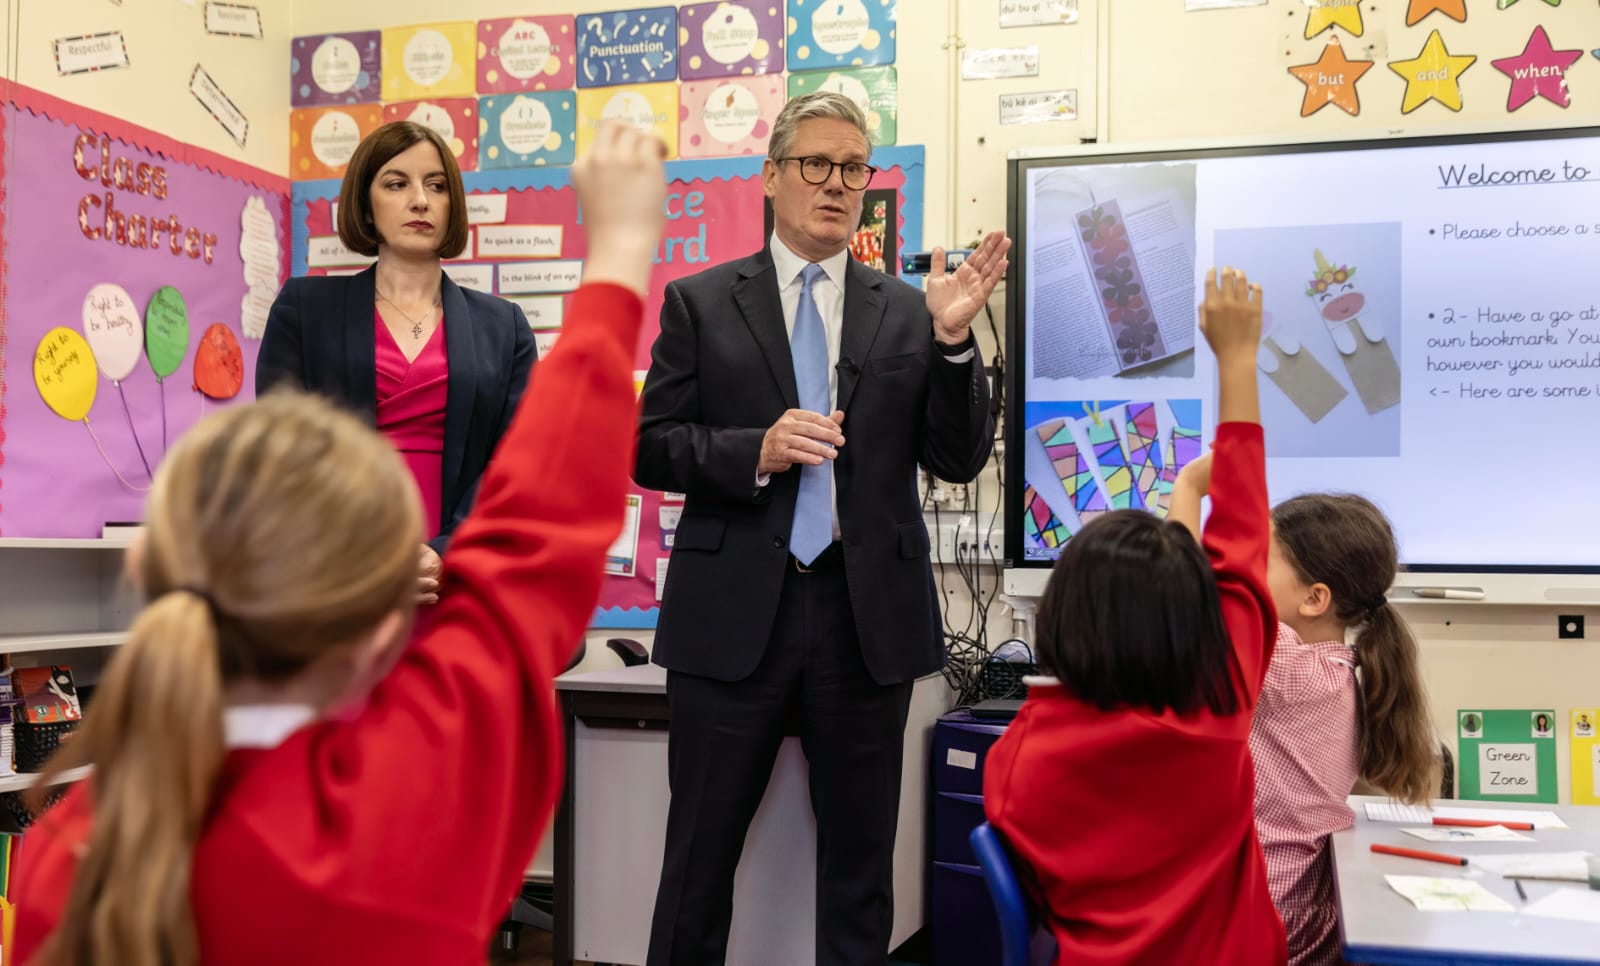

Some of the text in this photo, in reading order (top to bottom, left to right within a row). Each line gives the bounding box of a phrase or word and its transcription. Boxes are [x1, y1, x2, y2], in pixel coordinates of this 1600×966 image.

[514, 31, 536, 41] ABC
[68, 40, 113, 57] Respectful
[589, 40, 664, 58] Punctuation
[1318, 72, 1345, 86] but
[1417, 66, 1450, 81] and
[1513, 63, 1563, 80] when
[73, 132, 169, 200] Class
[1438, 160, 1591, 187] Welcome to
[78, 192, 218, 265] Charter
[1442, 223, 1501, 240] Please
[1506, 220, 1570, 238] choose
[1575, 223, 1589, 236] a
[484, 237, 493, 245] As
[495, 236, 514, 247] quick
[502, 275, 511, 283] In
[512, 274, 523, 283] the
[524, 273, 543, 282] blink
[544, 272, 552, 283] of
[553, 273, 563, 281] an
[90, 295, 125, 320] Right to
[1477, 306, 1526, 324] Have
[1530, 310, 1545, 322] a
[1549, 310, 1574, 328] go
[1579, 304, 1600, 321] at
[37, 333, 69, 366] Right to
[1427, 336, 1466, 349] own
[1426, 351, 1600, 377] however you would
[1460, 382, 1502, 398] Here
[1506, 385, 1538, 398] are
[1543, 385, 1592, 398] some
[1486, 747, 1531, 762] Green
[1489, 771, 1529, 786] Zone
